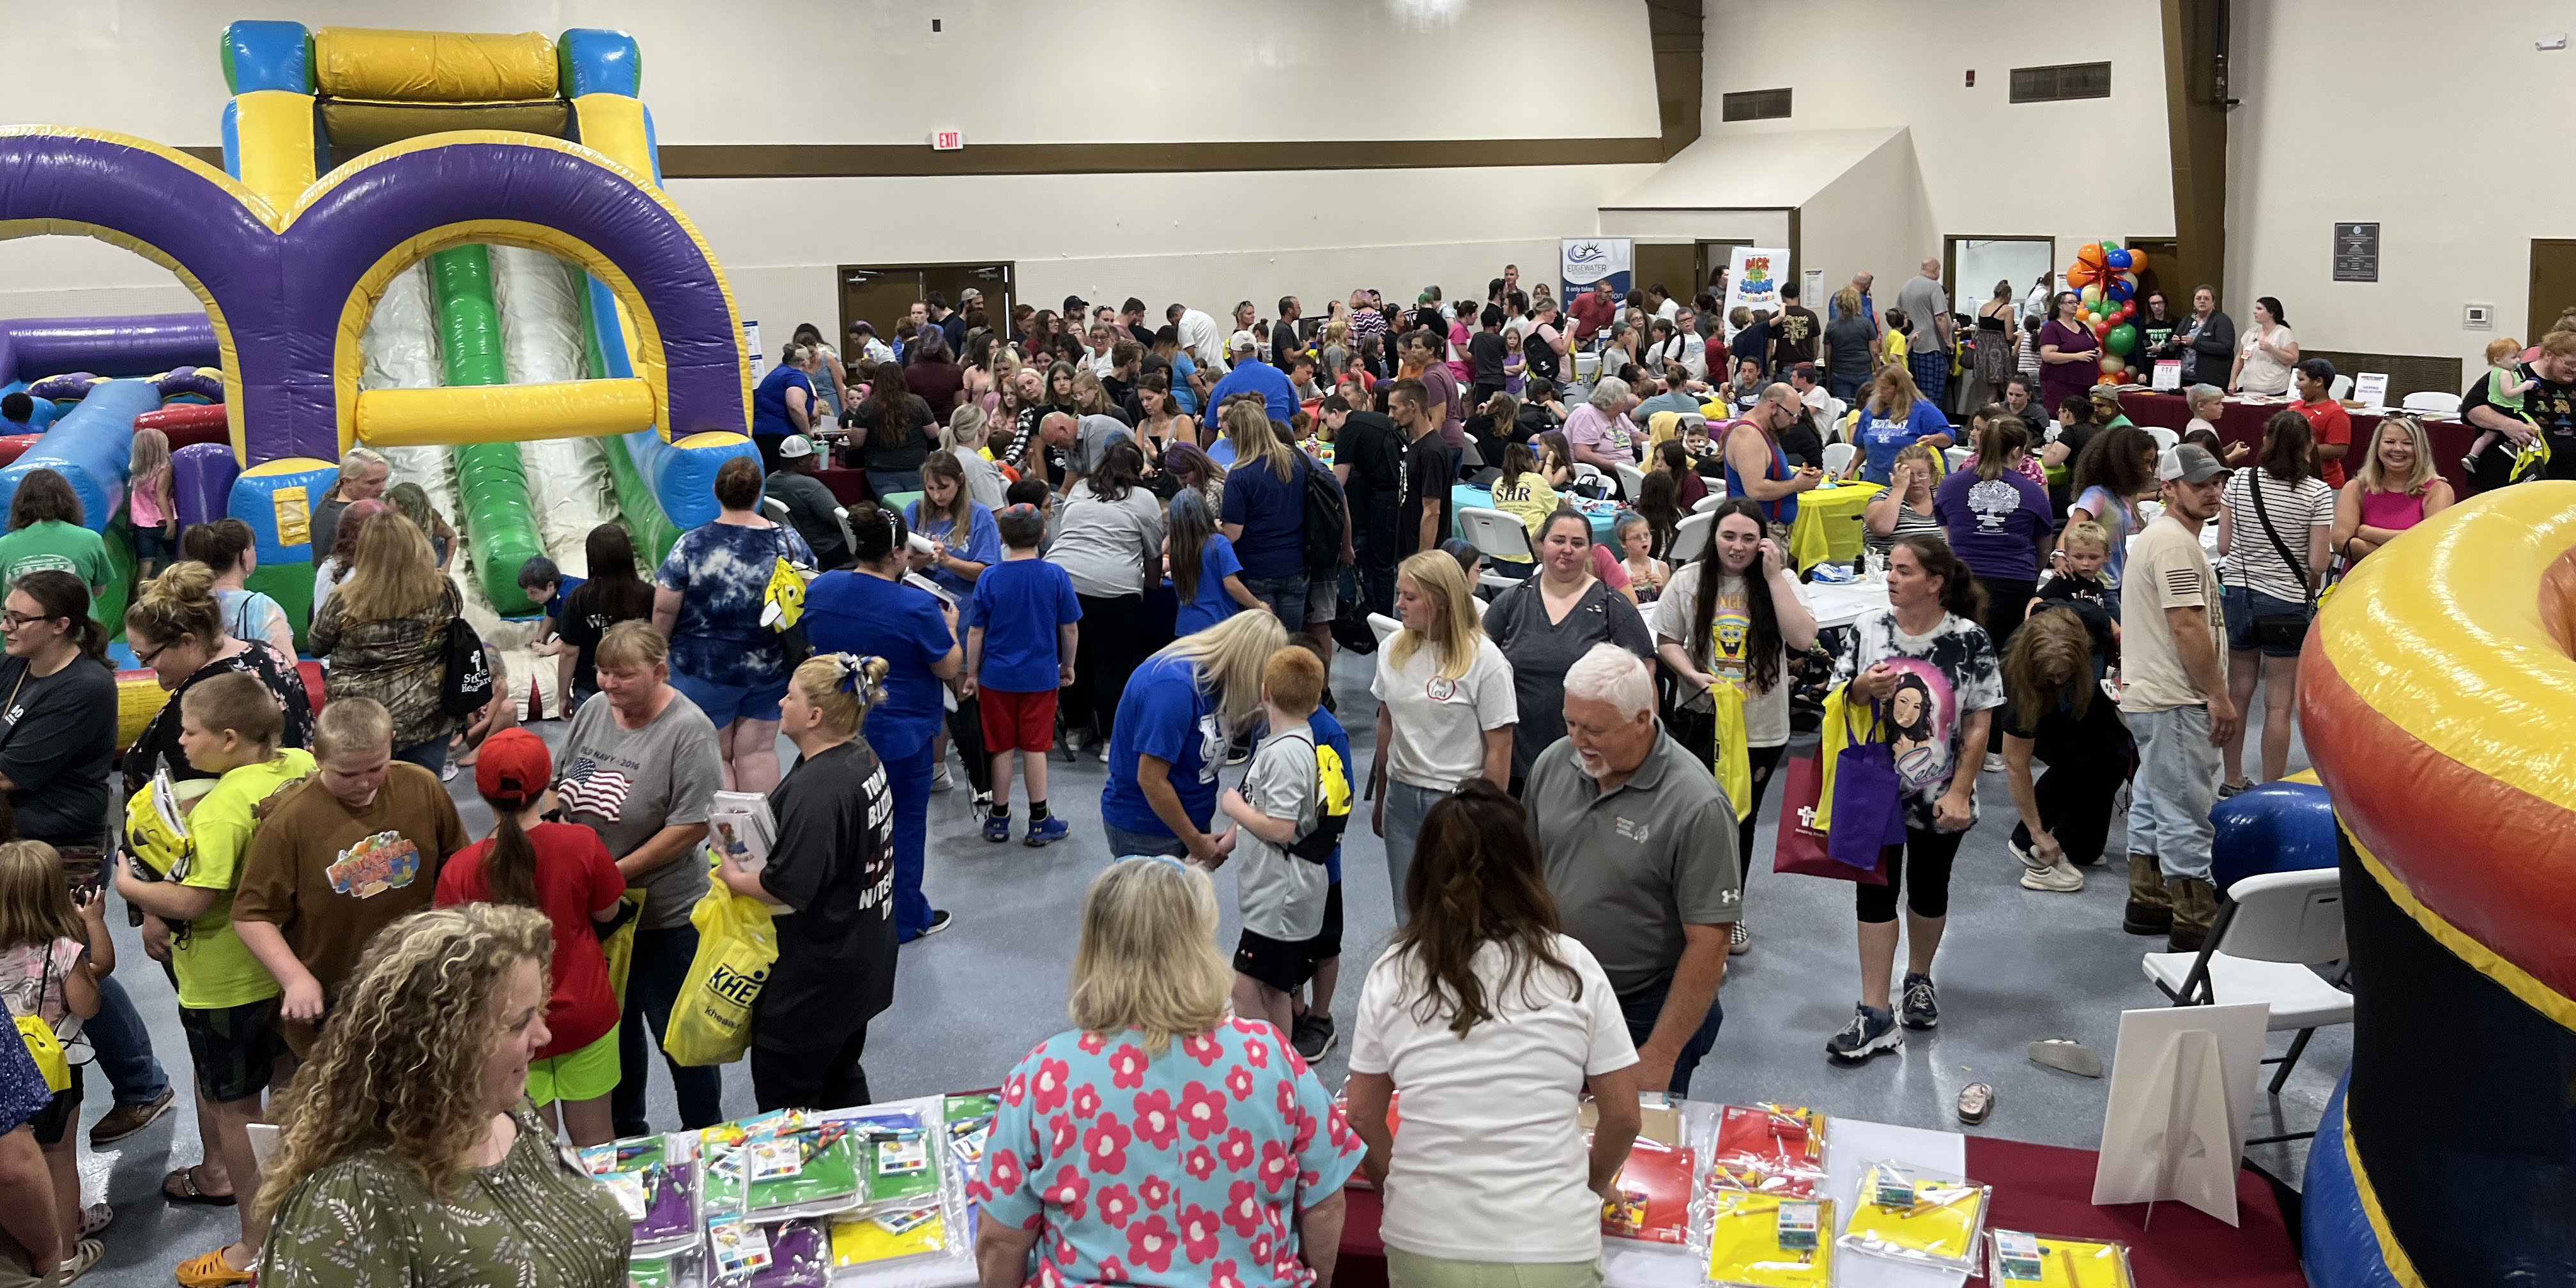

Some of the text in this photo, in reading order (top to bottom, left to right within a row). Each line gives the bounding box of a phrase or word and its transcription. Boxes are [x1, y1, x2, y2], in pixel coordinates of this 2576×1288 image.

[940, 132, 958, 148] EXIT
[1567, 264, 1607, 272] EDGEWATER
[1745, 257, 1770, 272] BACK
[1496, 487, 1531, 502] SHR
[593, 751, 617, 762] NAVY
[620, 759, 640, 770] 2016
[709, 966, 758, 1006] KHE
